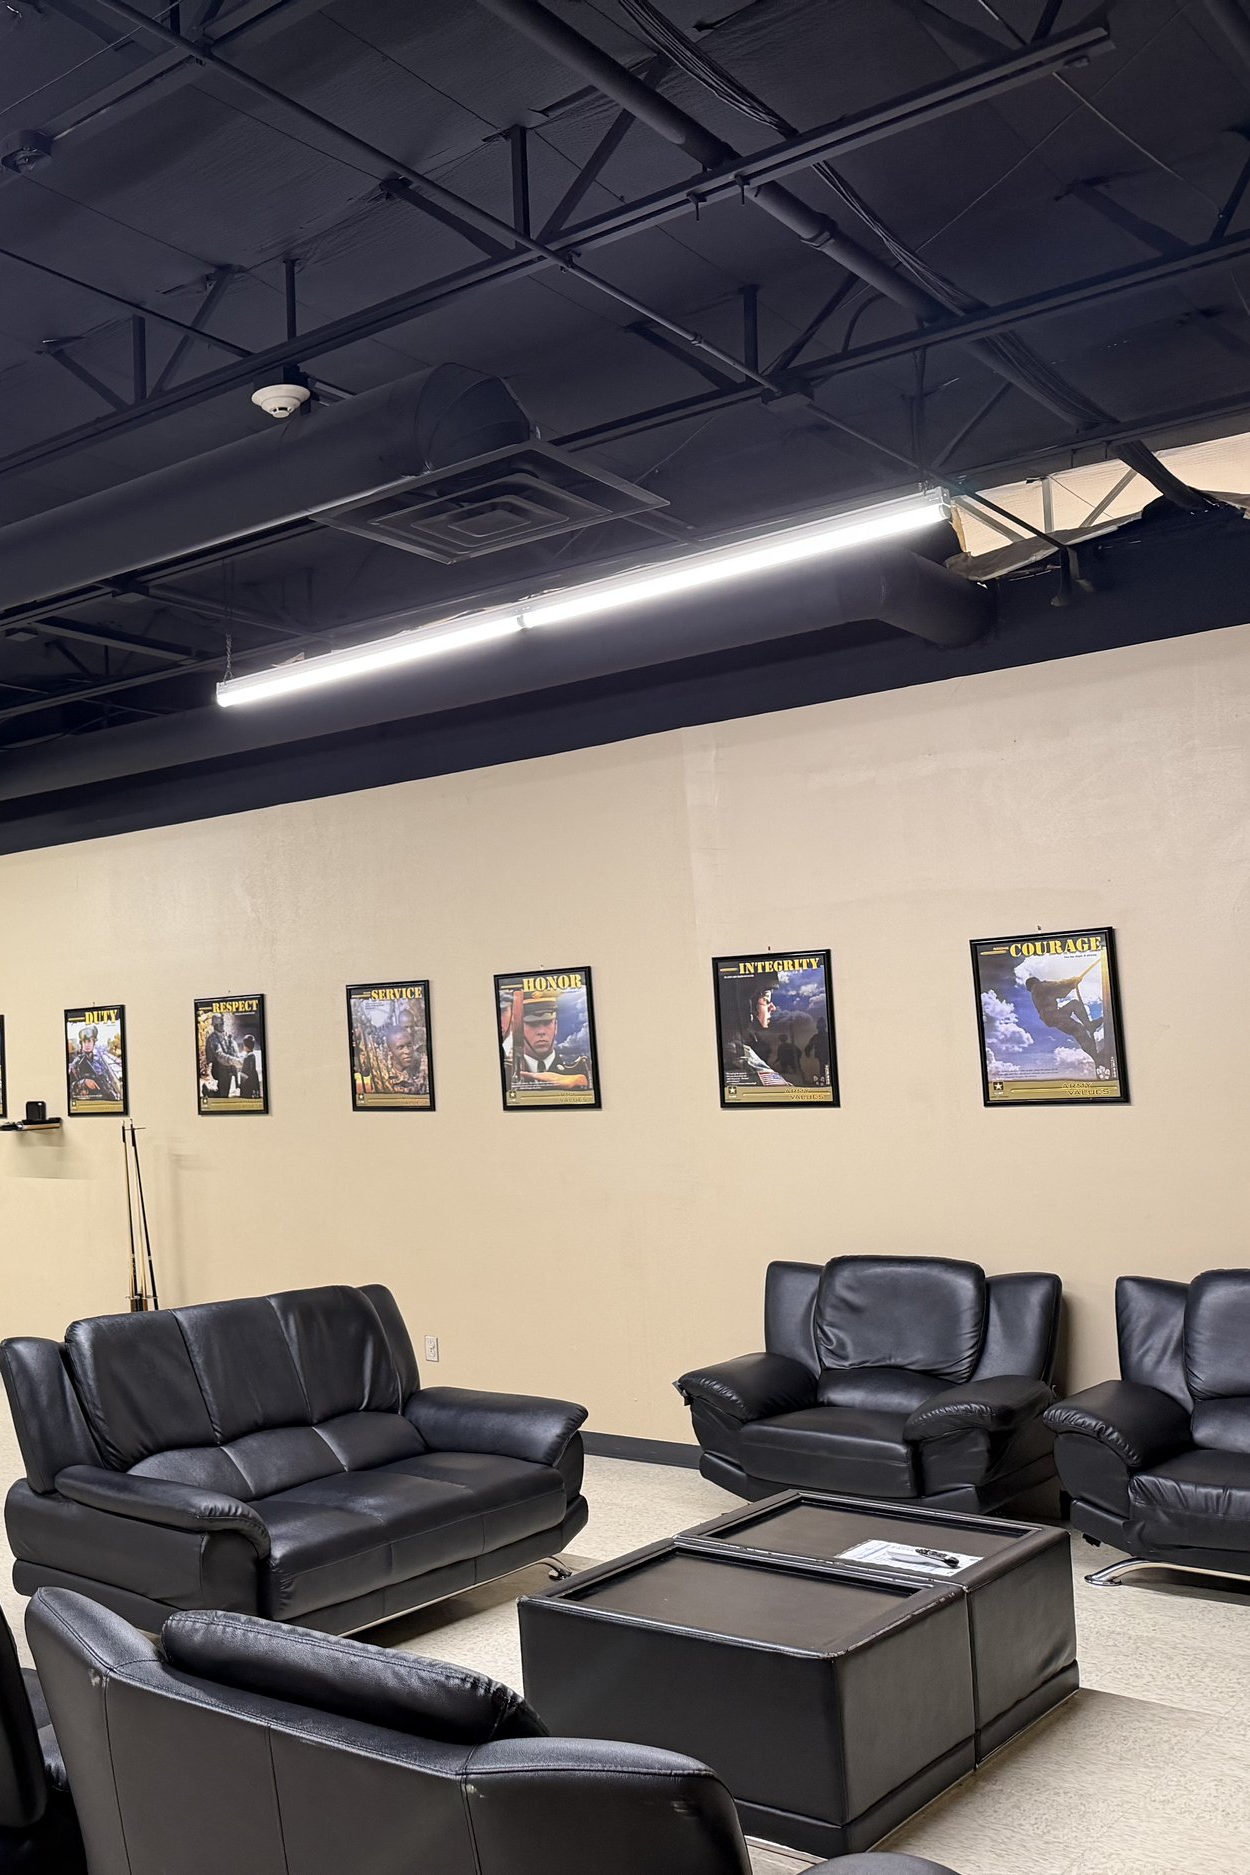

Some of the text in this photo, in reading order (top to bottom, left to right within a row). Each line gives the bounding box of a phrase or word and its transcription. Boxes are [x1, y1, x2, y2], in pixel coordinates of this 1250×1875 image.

[1009, 937, 1102, 958] COURAGE
[738, 958, 820, 975] INTEGRITY
[522, 974, 582, 992] HONOR
[370, 986, 423, 1001] SERVICE
[212, 1000, 259, 1013] RESPECT
[84, 1009, 118, 1025] DUTY
